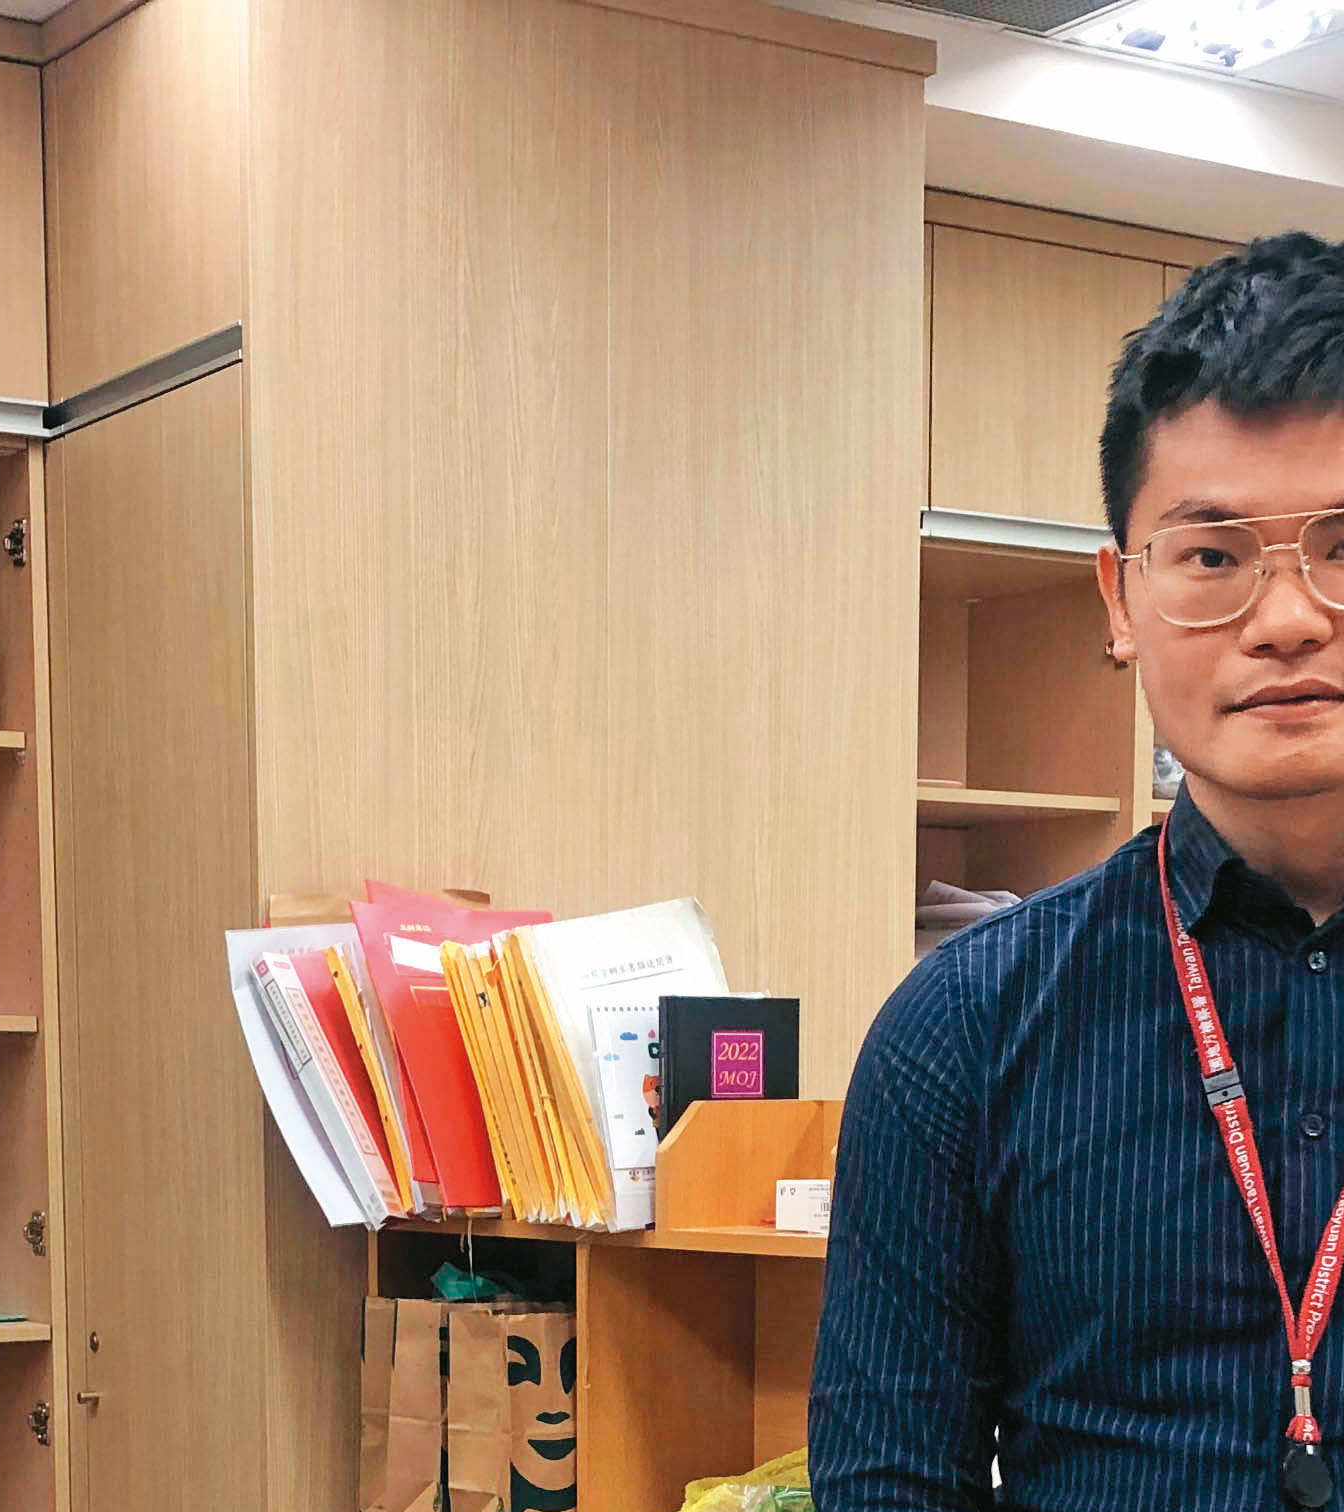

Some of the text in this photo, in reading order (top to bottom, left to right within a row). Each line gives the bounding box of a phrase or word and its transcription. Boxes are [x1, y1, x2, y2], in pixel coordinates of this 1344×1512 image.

[1183, 948, 1204, 993] Taiwan
[718, 1042, 759, 1061] 2022
[719, 1071, 758, 1088] MOJ
[1222, 1099, 1244, 1145] Distri
[1310, 1254, 1338, 1308] District
